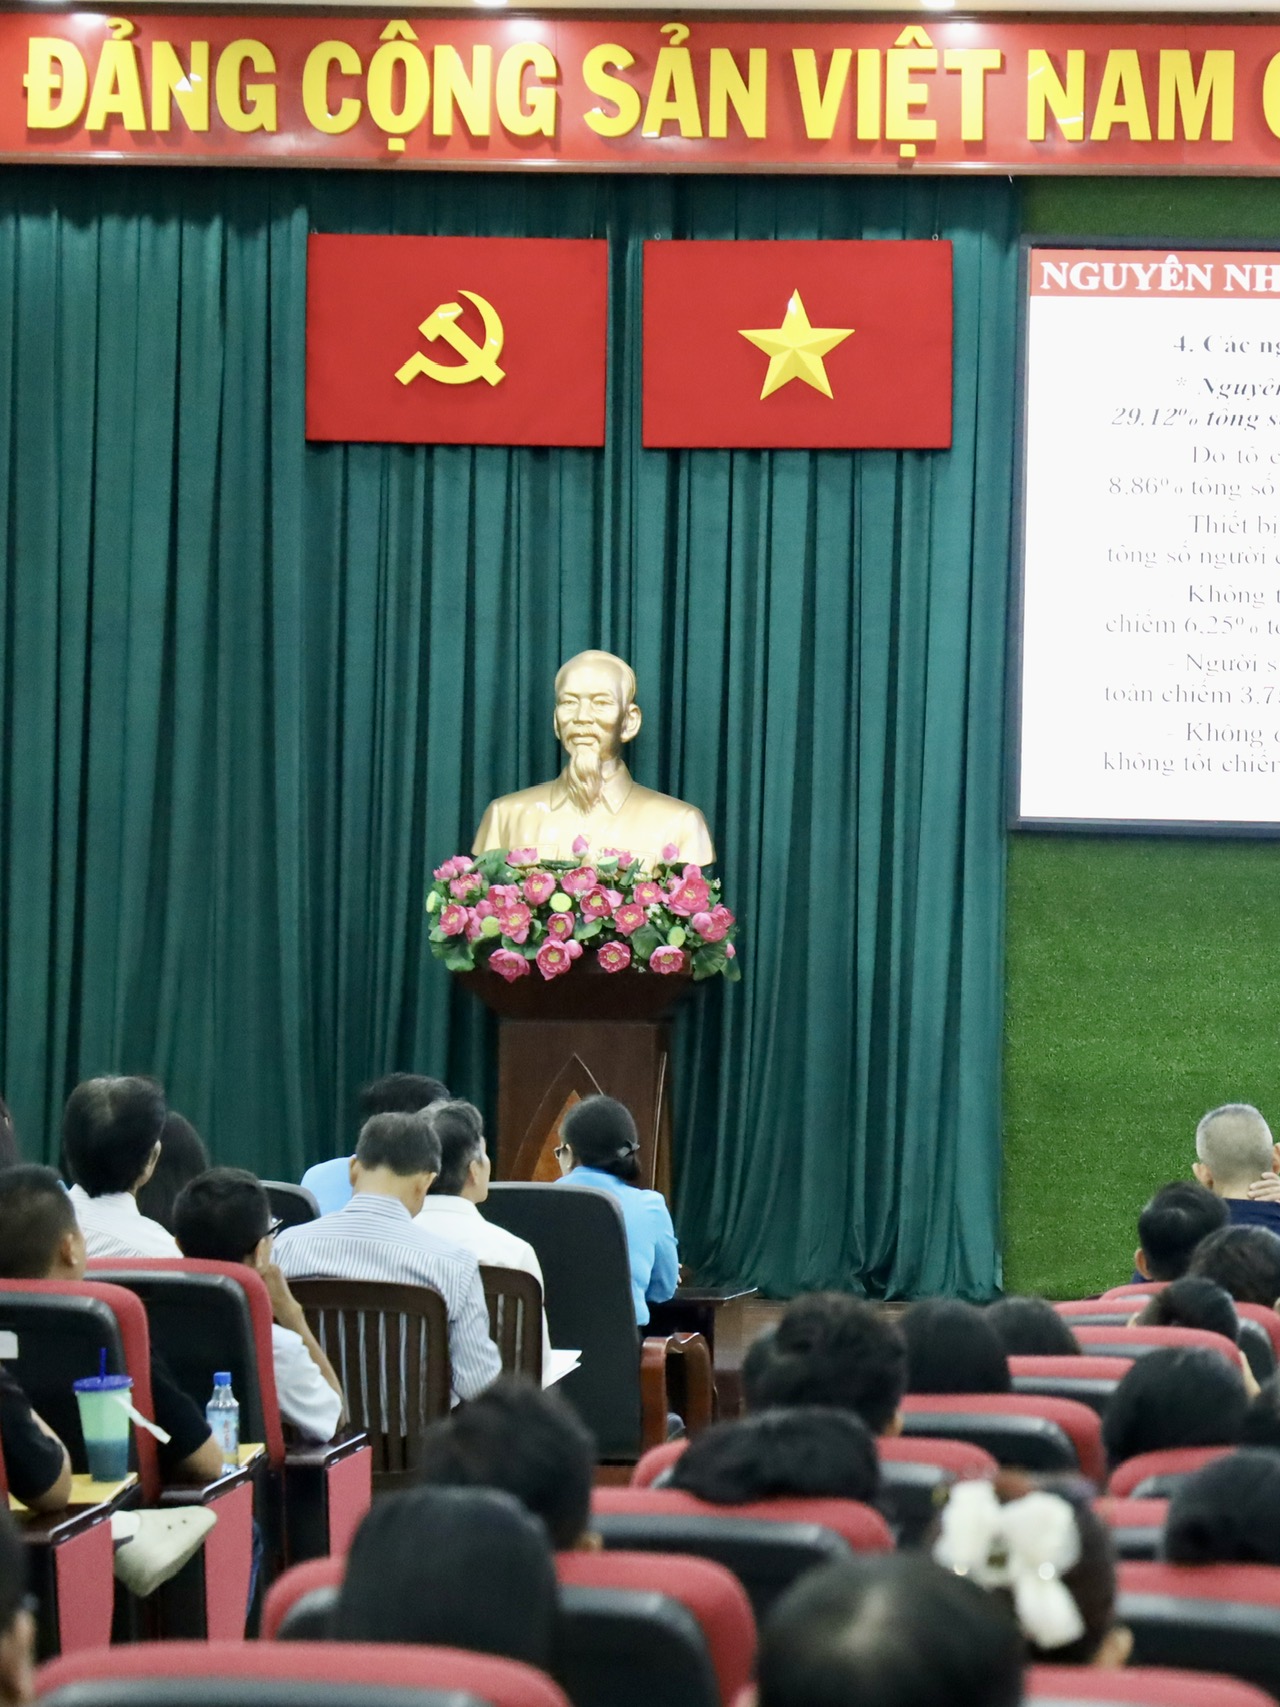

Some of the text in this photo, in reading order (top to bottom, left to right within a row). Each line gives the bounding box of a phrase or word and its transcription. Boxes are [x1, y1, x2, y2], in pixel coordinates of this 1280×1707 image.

[24, 18, 277, 133] ĐẢNG
[303, 20, 557, 152] CỘNG
[583, 23, 767, 140] SẢN
[793, 26, 1002, 157] VIỆT
[1027, 49, 1235, 142] NAM
[1040, 254, 1213, 291] NGUYÊN
[1172, 334, 1194, 353] 4.
[1202, 334, 1251, 354] Các
[1250, 472, 1275, 496] số
[1166, 539, 1191, 564] số
[1200, 545, 1266, 570] người
[1188, 584, 1266, 610] Không
[1105, 608, 1176, 634] chiếm
[1186, 653, 1257, 679] Người
[1105, 682, 1153, 703] toàn
[1161, 679, 1232, 704] chiếm
[1186, 722, 1264, 749] Không
[1103, 751, 1175, 777] không
[1183, 747, 1212, 772] tốt
